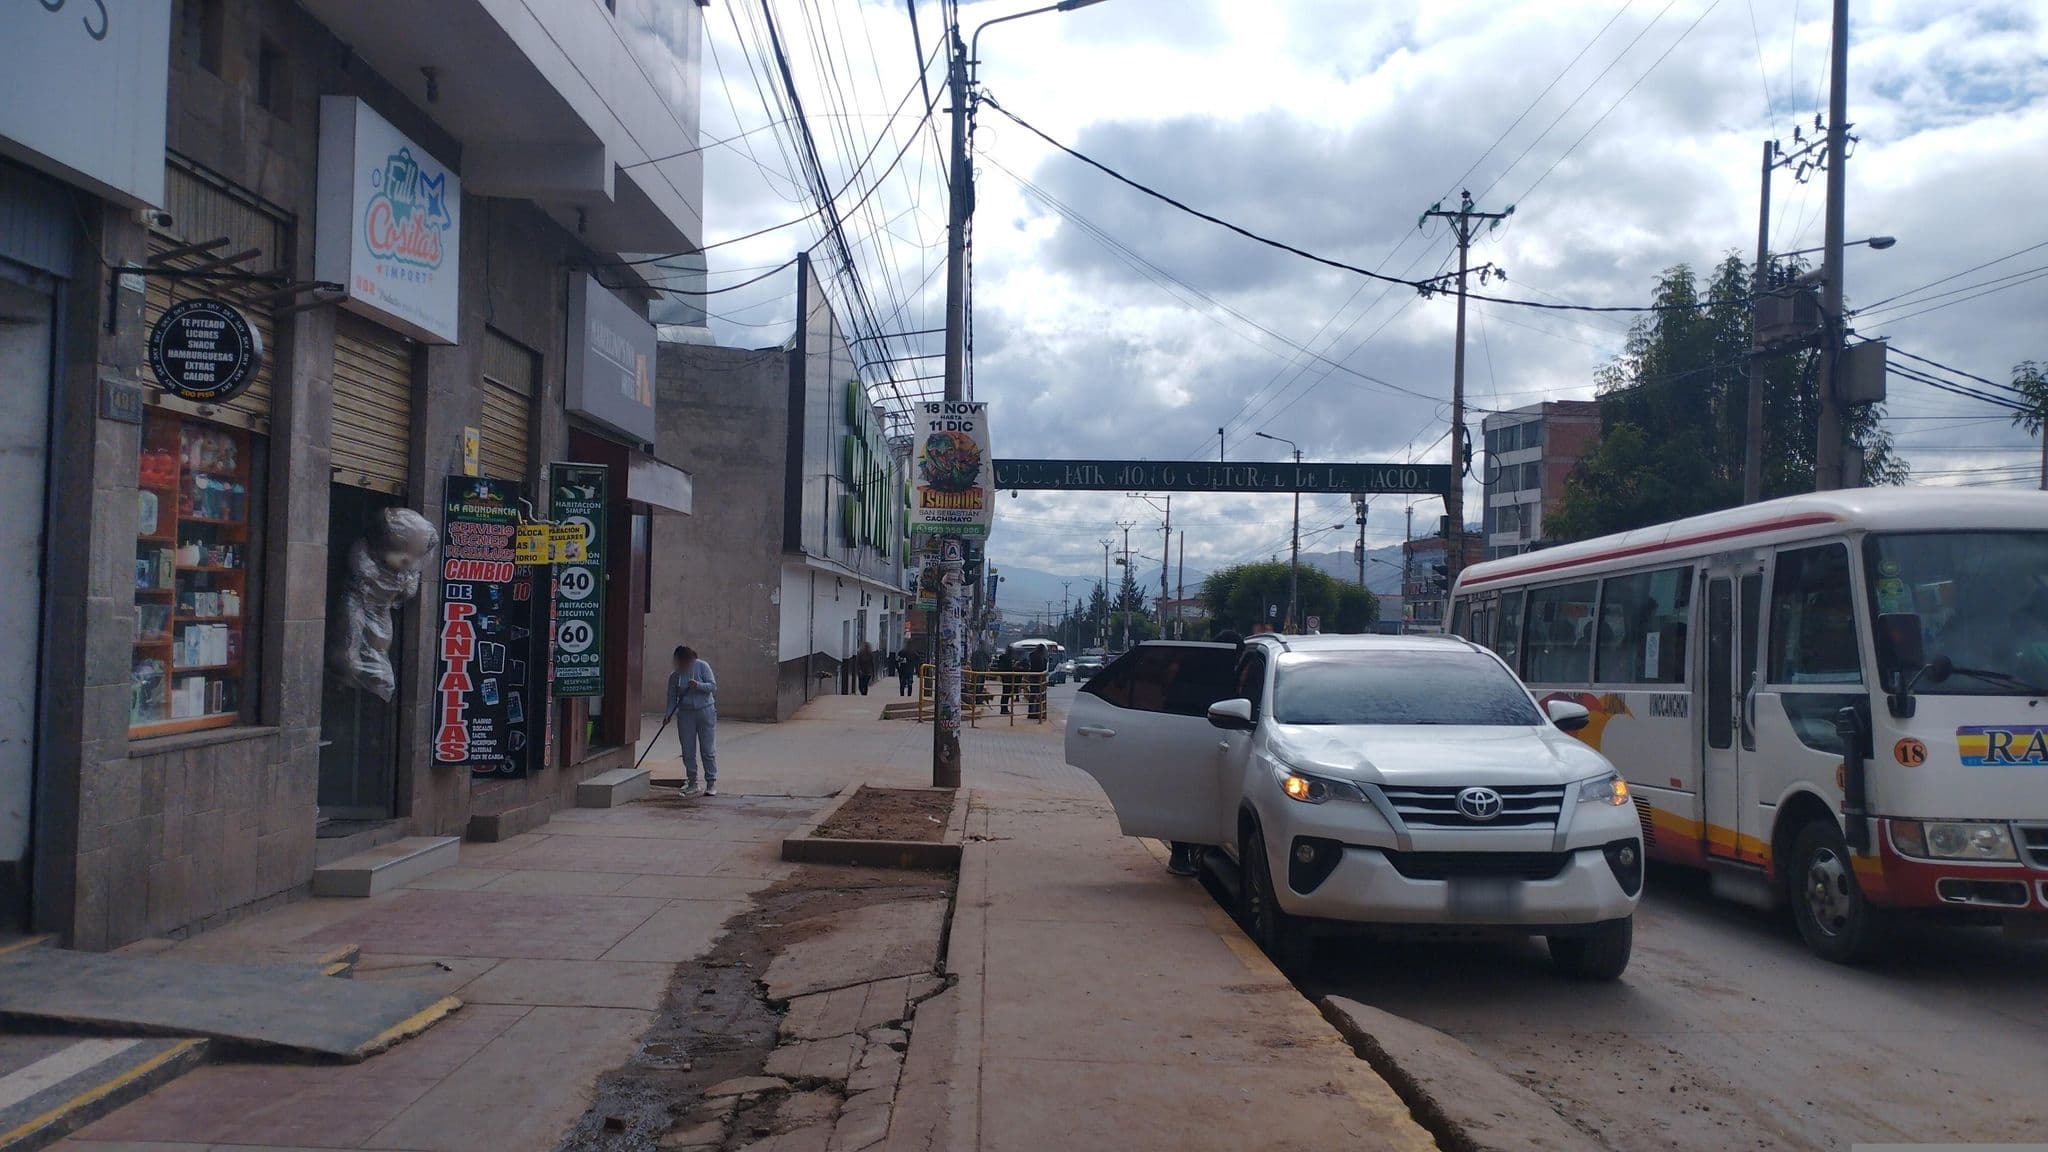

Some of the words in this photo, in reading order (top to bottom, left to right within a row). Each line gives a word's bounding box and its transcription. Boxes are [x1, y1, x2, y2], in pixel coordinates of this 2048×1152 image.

[368, 199, 442, 263] Cositas
[384, 265, 430, 284] IMPORT
[182, 319, 191, 328] TE
[192, 319, 226, 329] PITEADO
[186, 329, 219, 339] LICORES
[188, 340, 215, 350] SNACK
[168, 349, 234, 362] HAMBURGUESAS
[185, 361, 215, 371] EXTRAS
[184, 372, 215, 382] CALDOS
[924, 403, 940, 414] 18
[945, 403, 979, 415] NOV
[929, 421, 942, 431] 11
[946, 421, 973, 432] DIC
[449, 503, 460, 512] LA
[462, 505, 517, 516] ABUNDANCIA
[556, 501, 601, 509] HABITACIÓN
[919, 509, 936, 517] SAN
[449, 521, 515, 538] SERVICIO
[517, 529, 543, 537] OLOCA
[445, 559, 515, 583] CAMBIO
[562, 573, 589, 590] 40
[446, 584, 472, 599] DE
[561, 625, 588, 643] 60
[435, 602, 478, 762] PANTALLAS
[1900, 746, 1925, 763] 18
